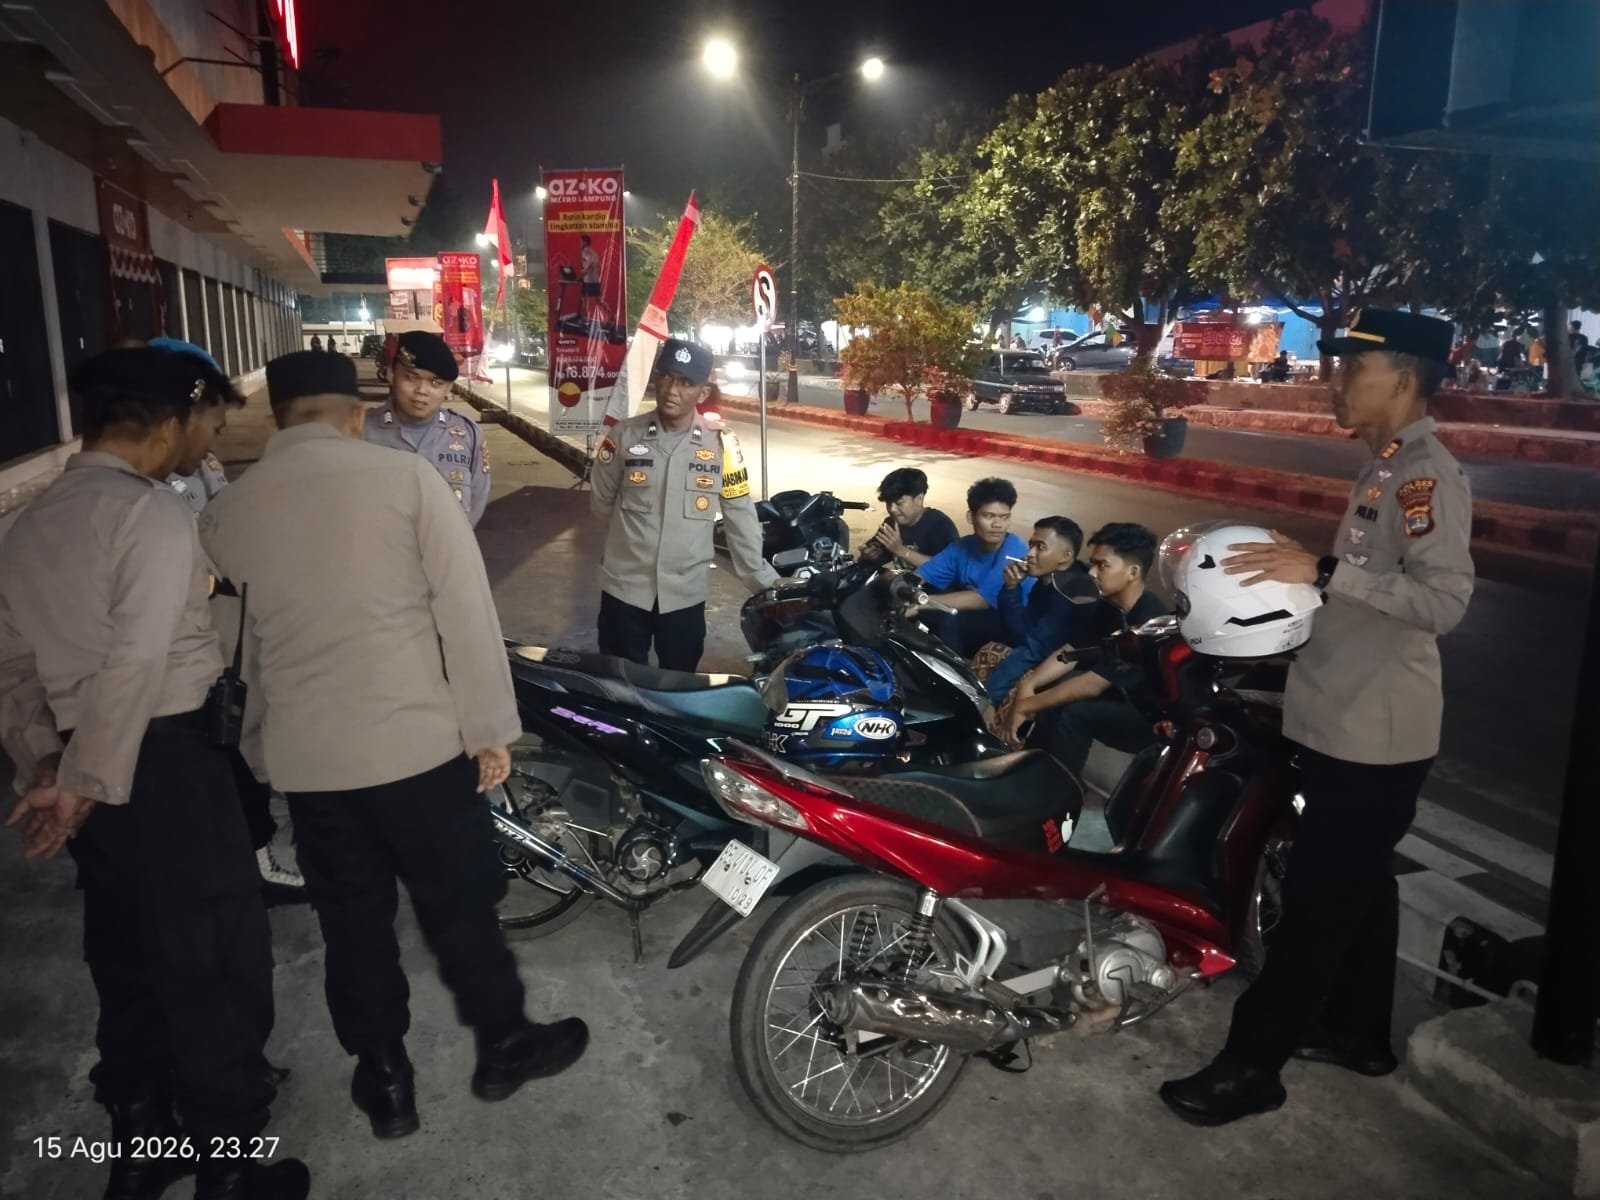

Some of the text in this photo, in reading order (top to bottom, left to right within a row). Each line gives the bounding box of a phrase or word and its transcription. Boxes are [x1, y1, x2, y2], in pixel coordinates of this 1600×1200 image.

[578, 194, 616, 203] LAMPUNG
[438, 453, 471, 465] POLRI
[688, 462, 721, 474] POLRI
[861, 722, 894, 734] NHK
